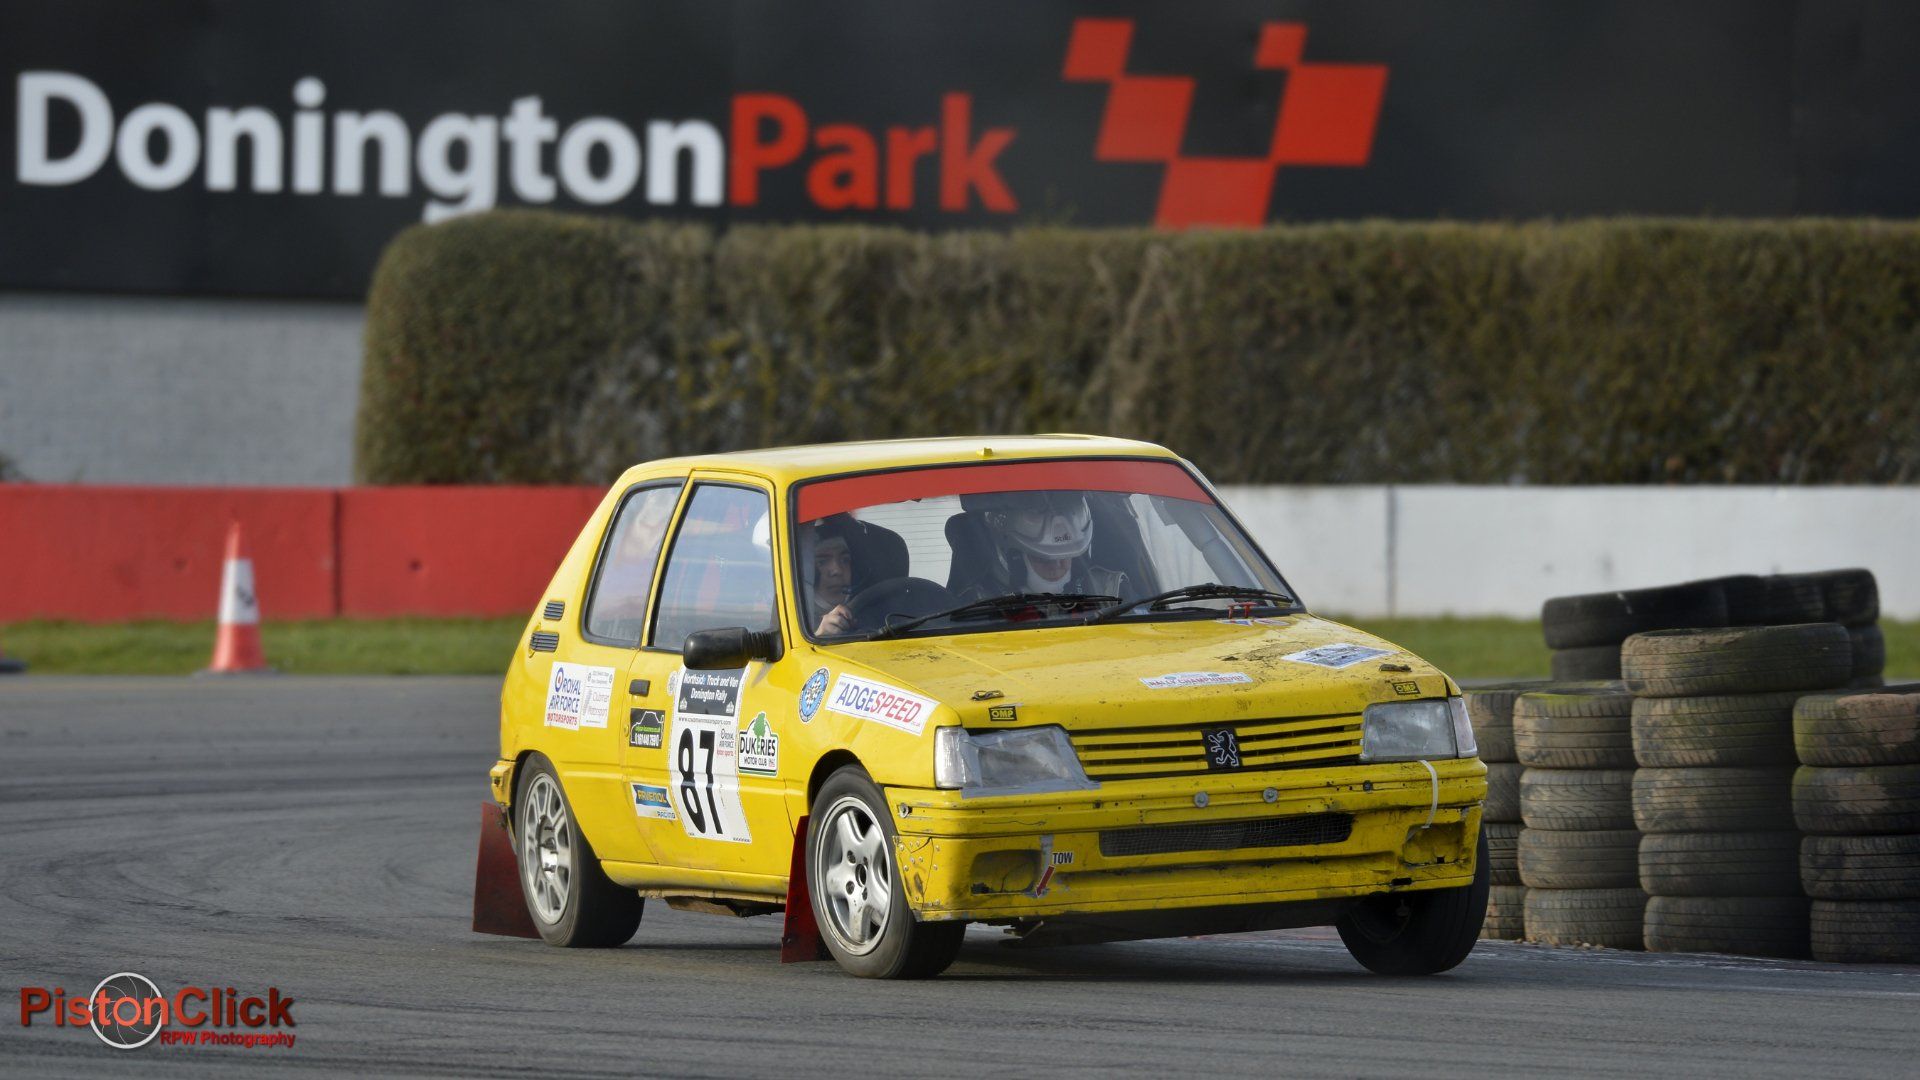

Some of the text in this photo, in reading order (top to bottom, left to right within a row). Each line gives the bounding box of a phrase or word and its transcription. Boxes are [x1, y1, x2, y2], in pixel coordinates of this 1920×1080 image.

[562, 677, 581, 695] ROYAL
[707, 674, 720, 687] Truck
[720, 676, 730, 687] and
[1396, 683, 1416, 692] OMP
[690, 687, 728, 704] Donington Rally
[836, 683, 922, 723] ADGESPEED
[548, 694, 581, 714] AIR FORCE
[547, 712, 578, 726] MOTORSPORTS
[991, 709, 1014, 718] OMP
[740, 736, 776, 757] DUKERIES
[744, 756, 758, 765] MOTOR
[758, 758, 768, 767] CLUB
[678, 728, 723, 834] 87
[1053, 852, 1073, 865] TOW
